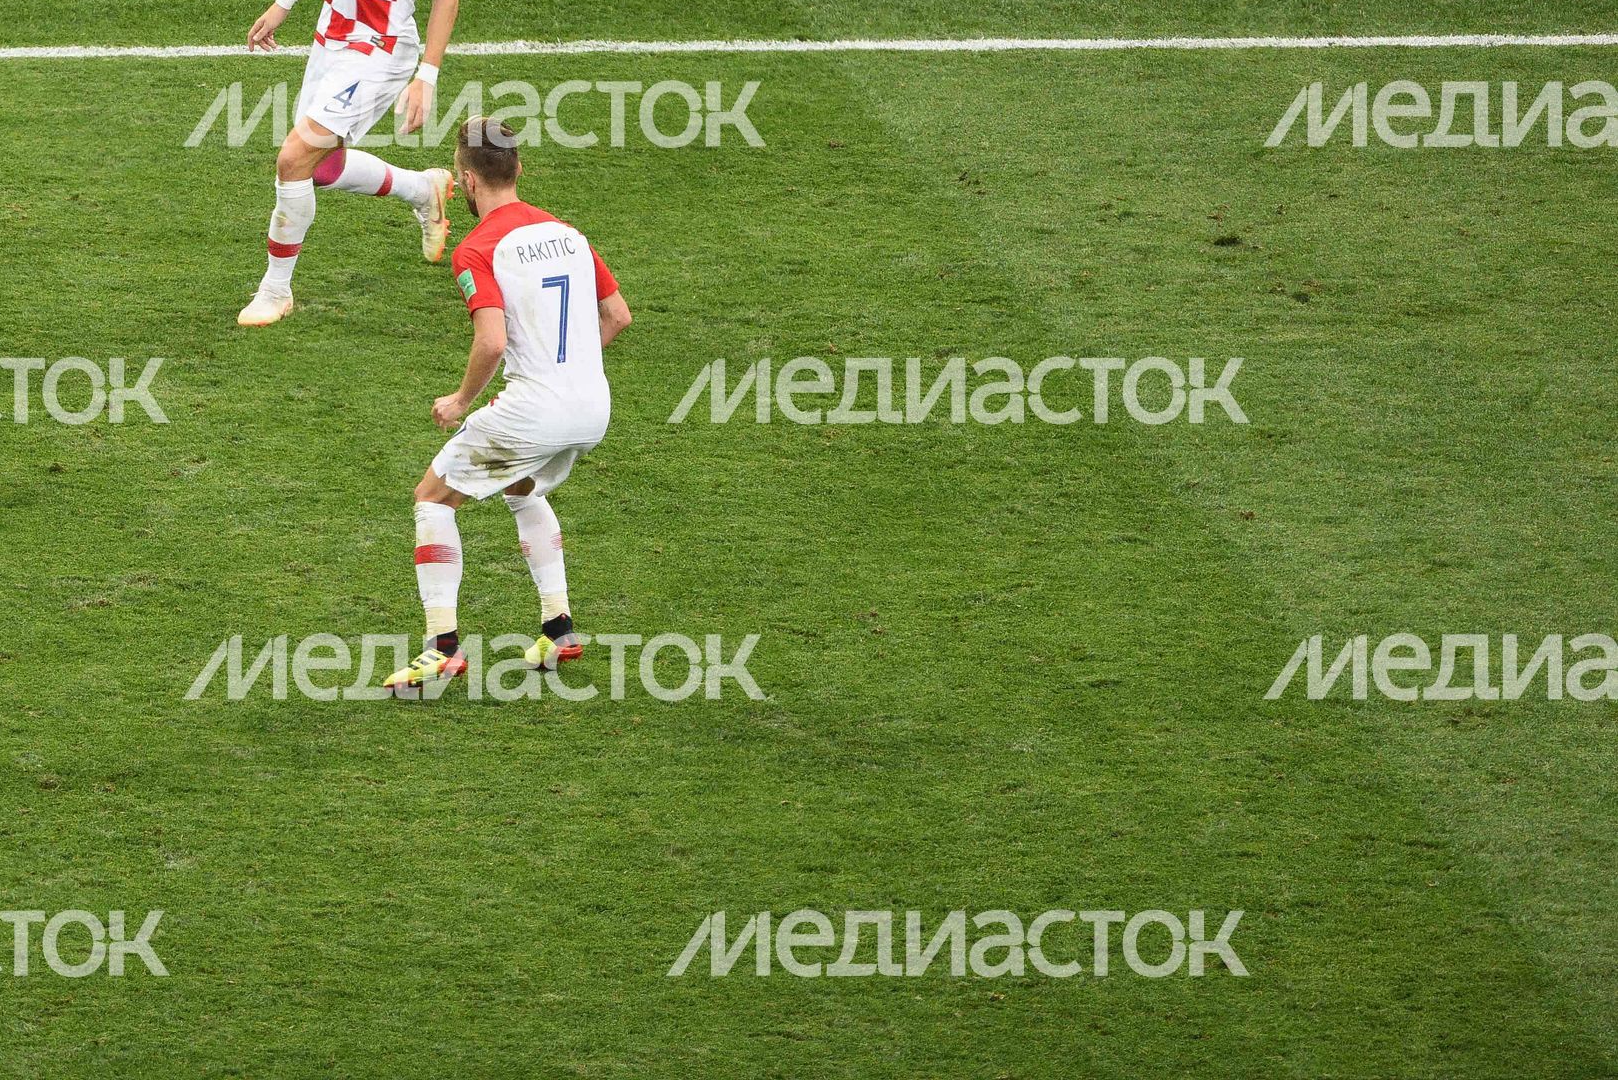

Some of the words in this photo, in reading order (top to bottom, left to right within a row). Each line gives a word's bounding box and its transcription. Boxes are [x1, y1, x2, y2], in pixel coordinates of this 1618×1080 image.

[333, 80, 360, 109] 4
[516, 234, 576, 264] RAKITIĆ
[542, 274, 570, 363] 7
